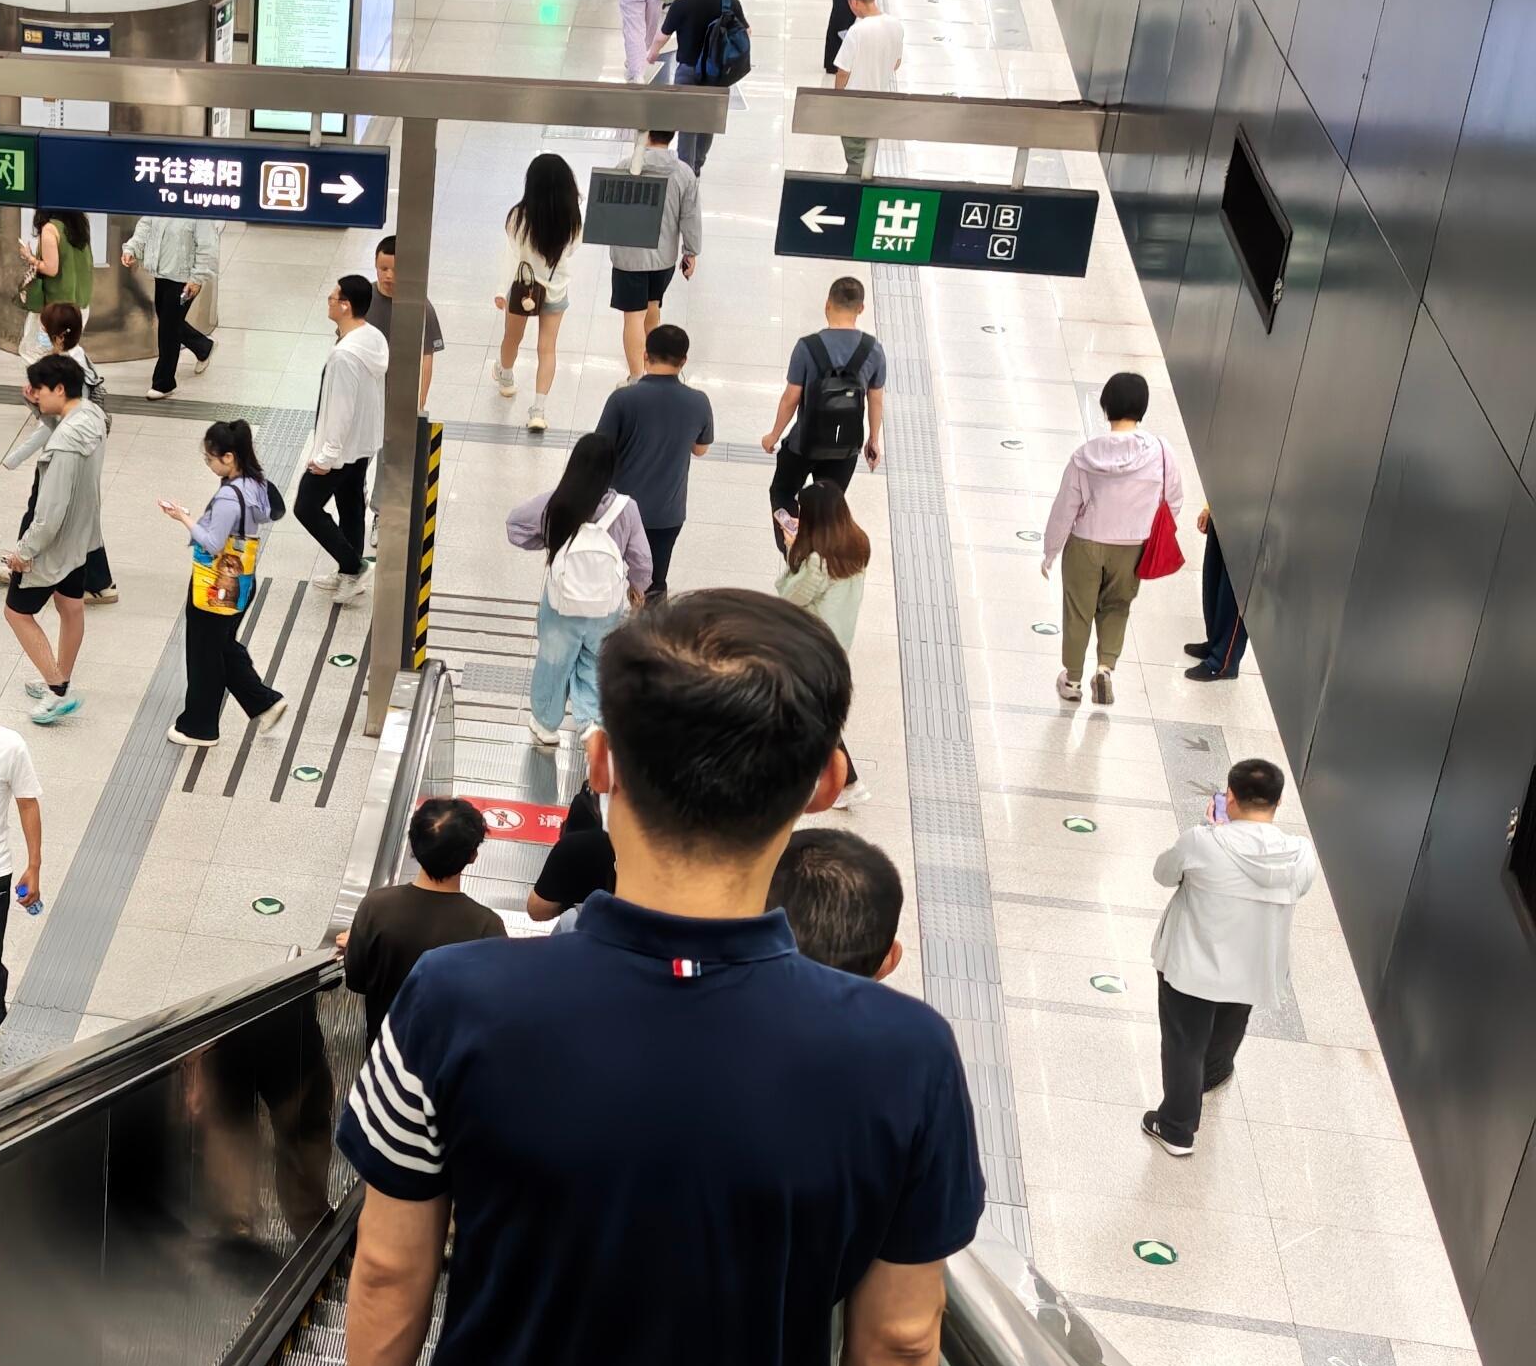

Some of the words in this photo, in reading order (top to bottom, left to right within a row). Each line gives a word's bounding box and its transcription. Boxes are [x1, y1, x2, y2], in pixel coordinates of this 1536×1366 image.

[134, 156, 242, 187] 开往潞阳
[158, 188, 177, 203] To
[183, 190, 240, 209] Luyang
[872, 236, 915, 251] EXIT
